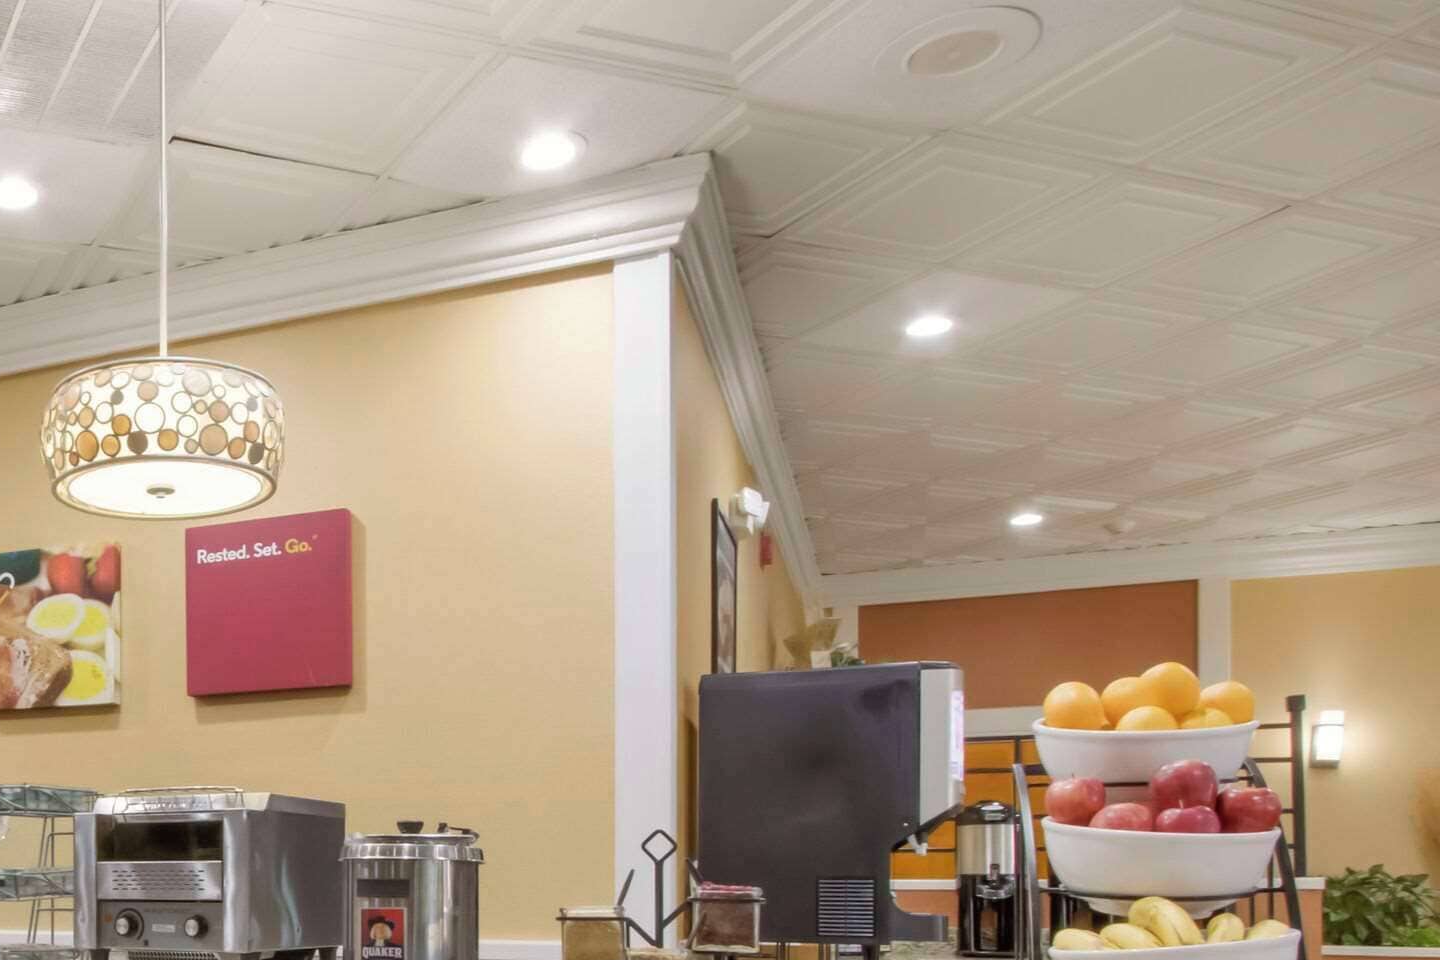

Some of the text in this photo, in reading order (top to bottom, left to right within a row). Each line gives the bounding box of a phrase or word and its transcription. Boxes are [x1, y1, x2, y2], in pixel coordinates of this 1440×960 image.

[197, 538, 312, 564] Rested. Set. Go.
[362, 946, 402, 959] QUAKER
